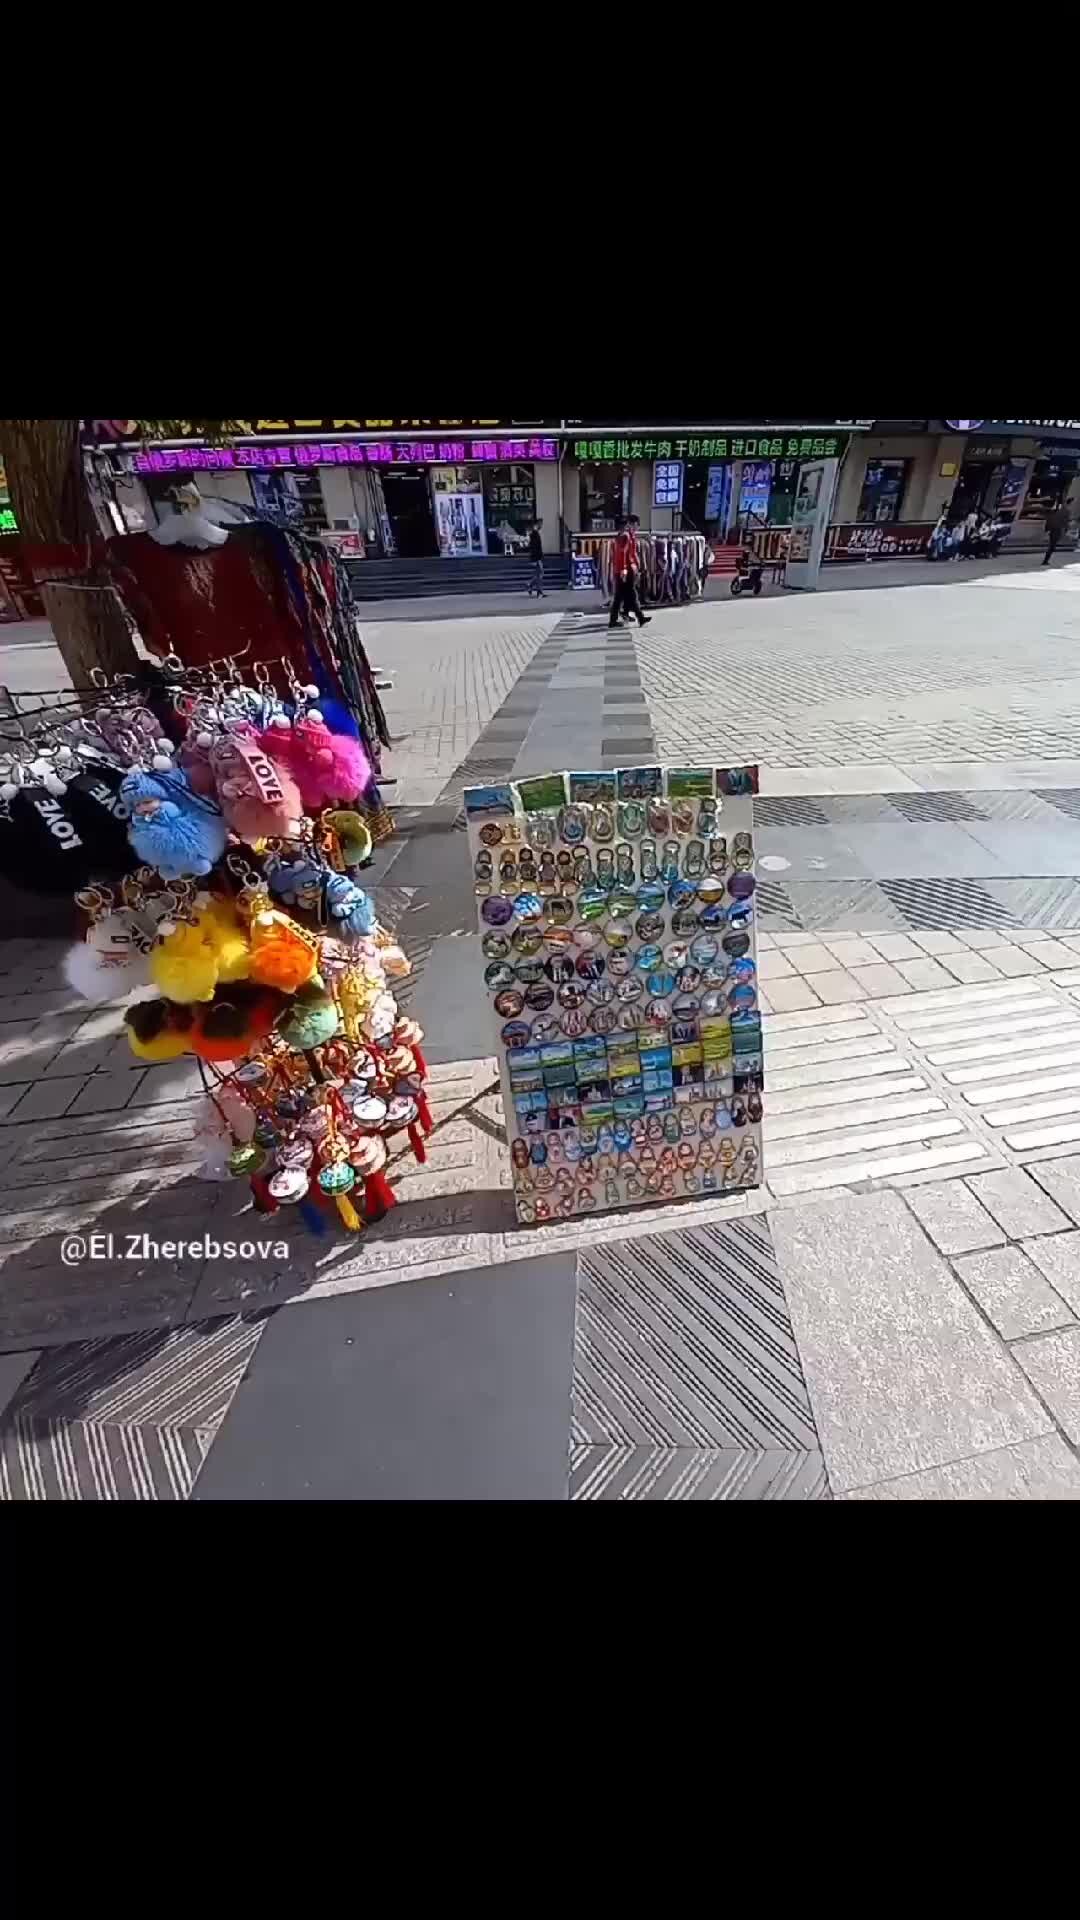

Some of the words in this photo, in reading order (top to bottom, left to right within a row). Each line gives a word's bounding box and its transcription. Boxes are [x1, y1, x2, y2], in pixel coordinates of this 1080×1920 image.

[732, 438, 782, 456] 进口食品
[248, 756, 284, 800] LOVE
[89, 783, 130, 820] OVE
[34, 799, 83, 850] LOVE
